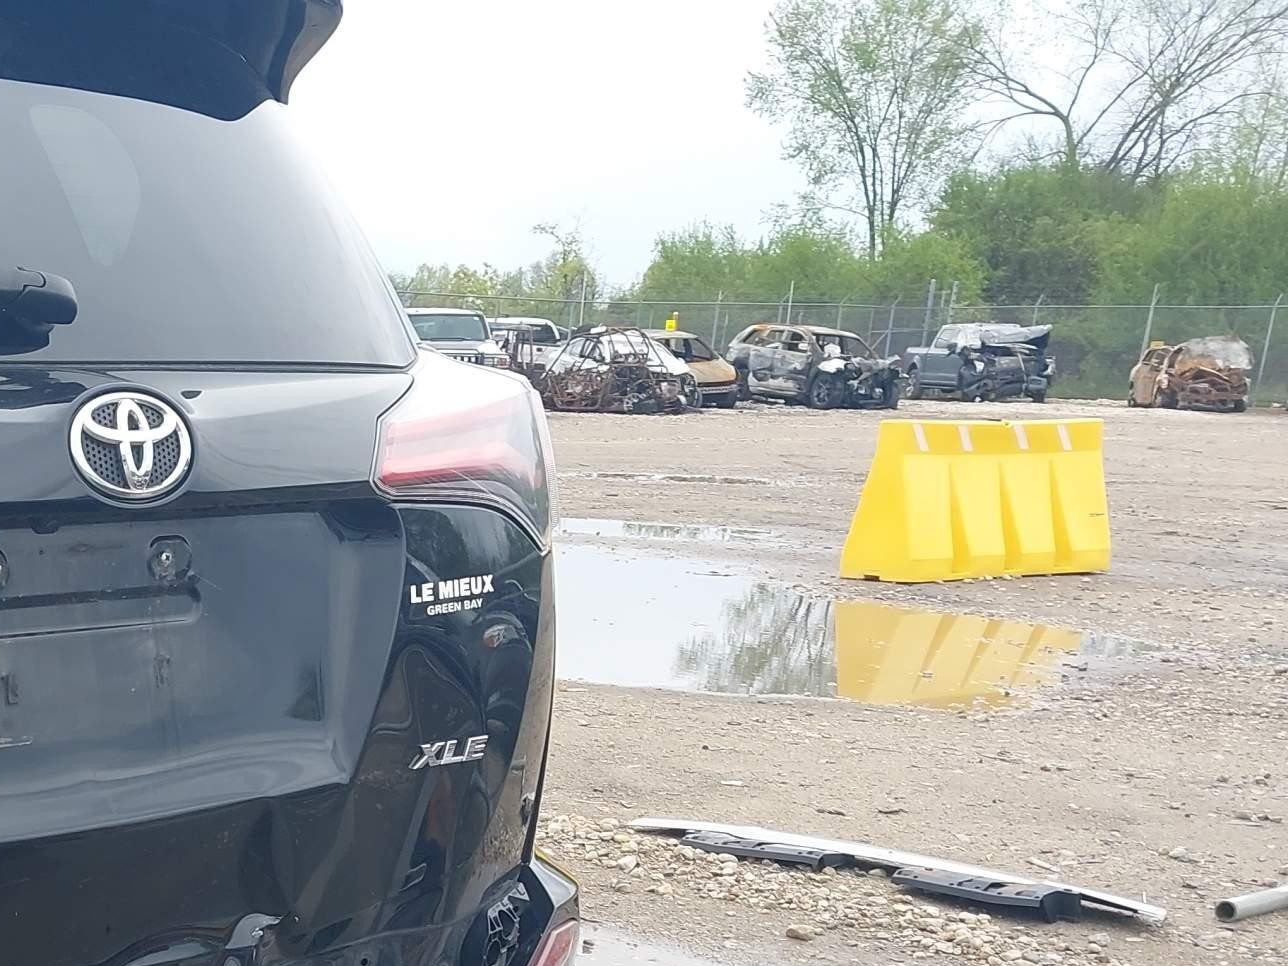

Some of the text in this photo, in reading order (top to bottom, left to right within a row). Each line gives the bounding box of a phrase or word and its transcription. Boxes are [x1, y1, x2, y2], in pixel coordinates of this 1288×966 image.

[410, 574, 494, 603] LE MIEUX
[426, 598, 483, 616] GREEN BAY
[408, 734, 489, 770] XLE
